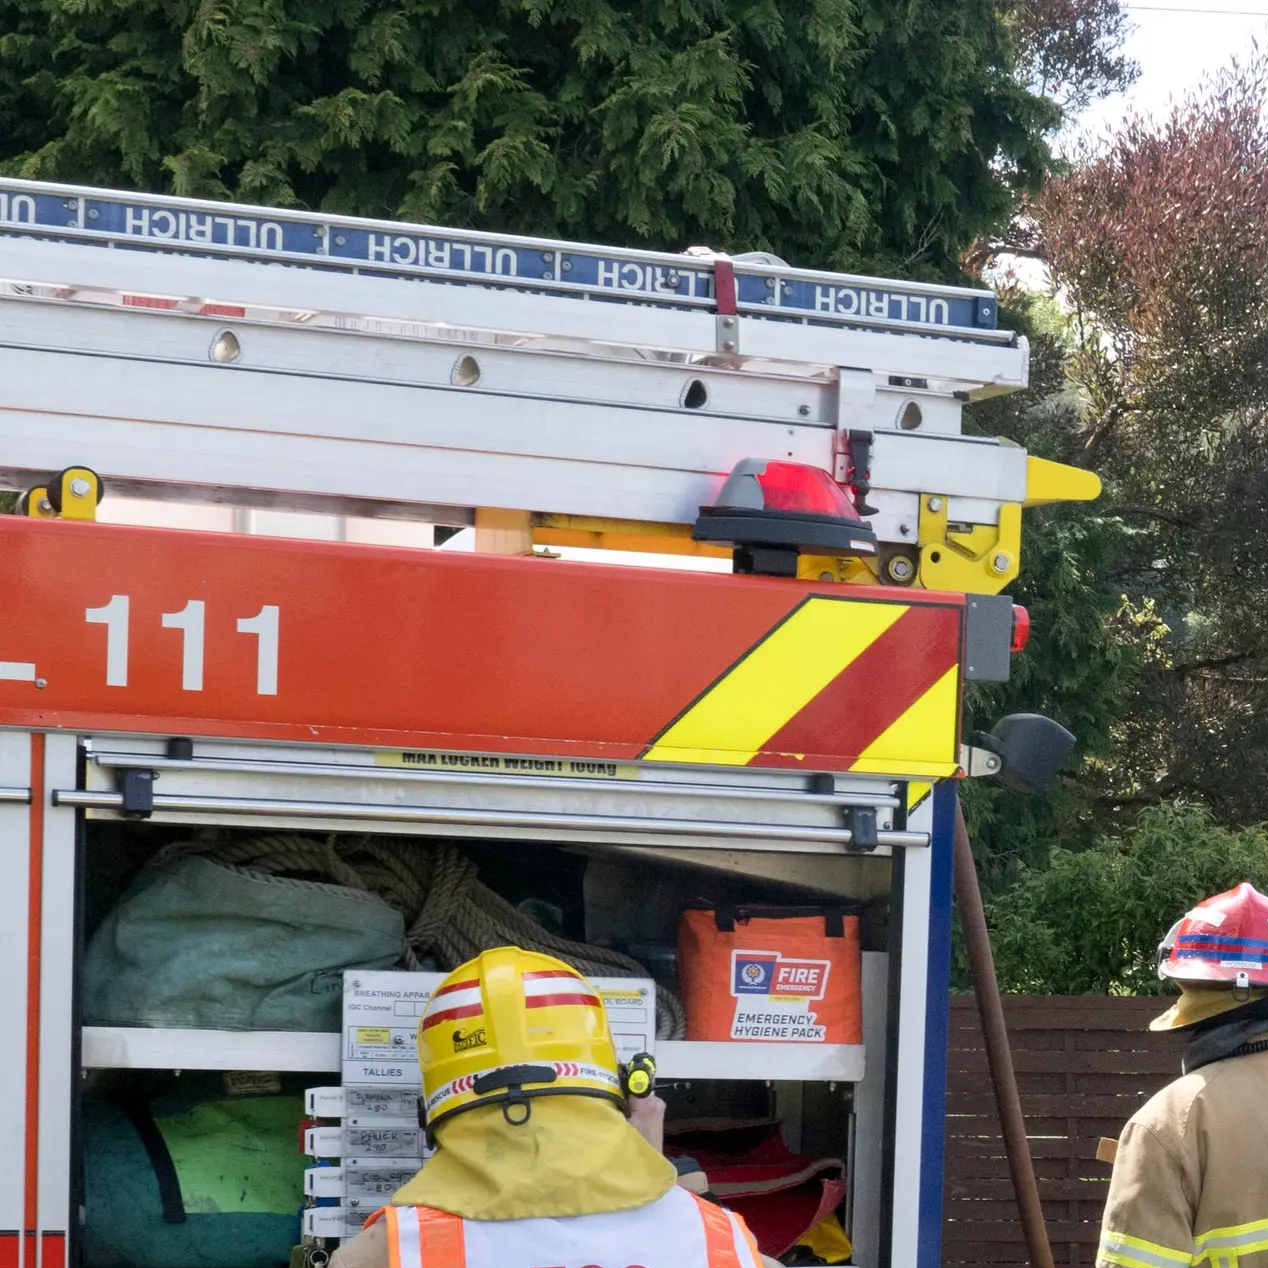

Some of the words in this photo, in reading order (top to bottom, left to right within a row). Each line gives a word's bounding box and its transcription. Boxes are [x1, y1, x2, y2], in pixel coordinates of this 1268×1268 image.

[126, 207, 283, 250] ULLRICH
[368, 234, 517, 276] ULLRICH
[598, 260, 739, 302] LLRICH
[815, 285, 949, 325] ULLRICH
[84, 594, 280, 696] 111
[778, 967, 820, 984] FIRE
[354, 989, 401, 999] BREATHING
[776, 984, 816, 992] EMERGENCY
[737, 1013, 813, 1025] EMERGENCY
[734, 1026, 790, 1037] HYGIENE
[791, 1027, 822, 1038] PACK
[363, 1068, 403, 1077] TALLIES
